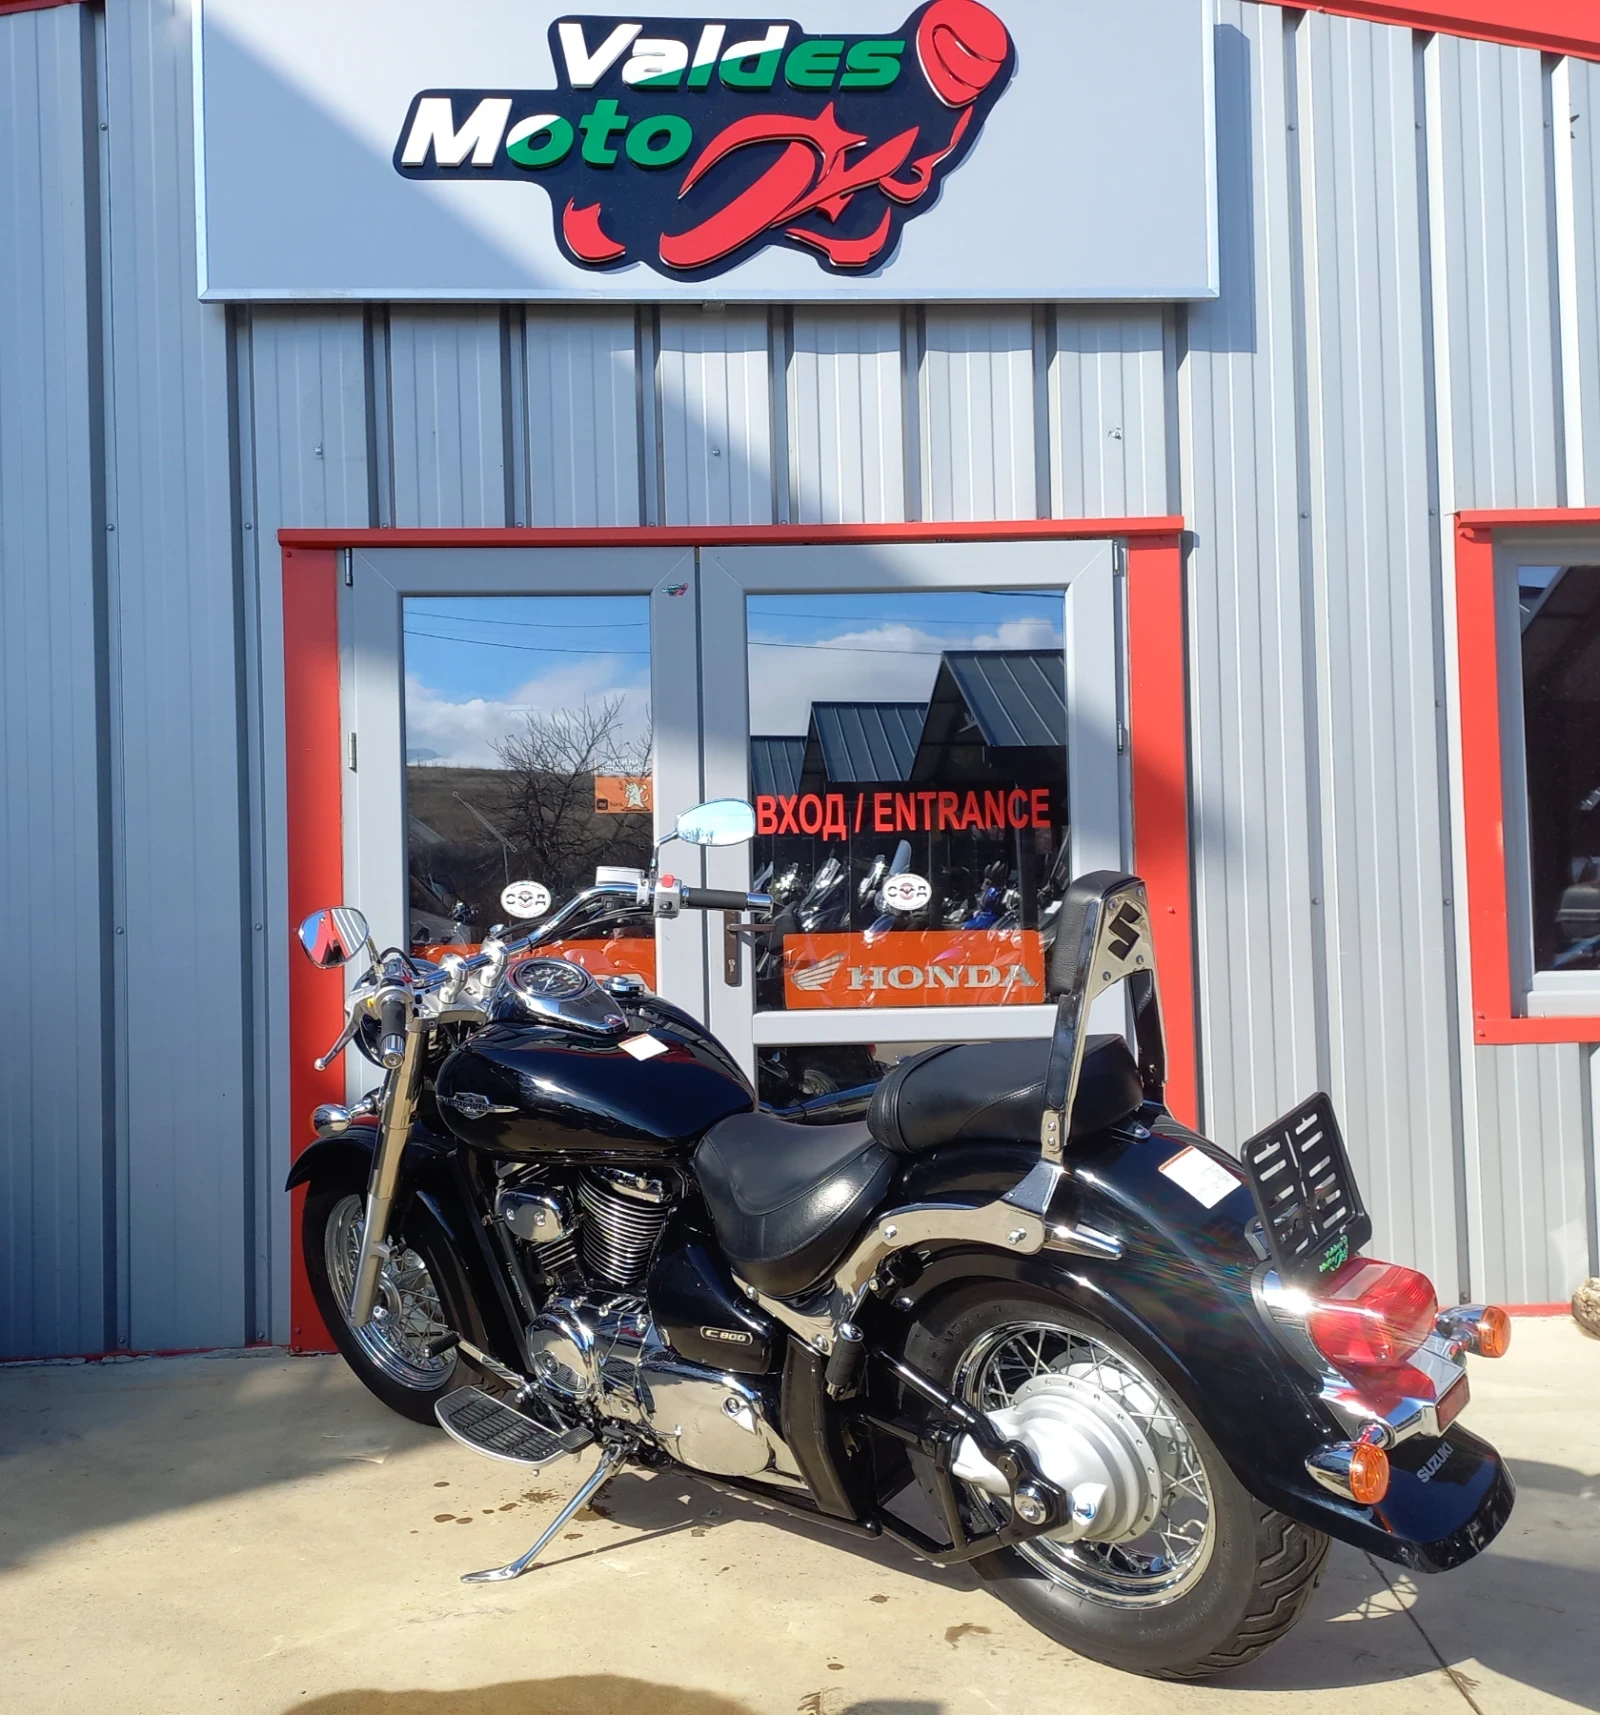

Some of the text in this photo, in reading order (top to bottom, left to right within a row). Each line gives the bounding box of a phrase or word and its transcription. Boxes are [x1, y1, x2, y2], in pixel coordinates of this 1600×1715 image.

[557, 22, 906, 91] Valdes
[400, 97, 693, 169] Moto
[756, 793, 847, 841] ВХОД
[873, 788, 1051, 832] ENTRANCE
[846, 964, 1038, 991] HONDA
[1416, 1440, 1454, 1483] SUZUKI
